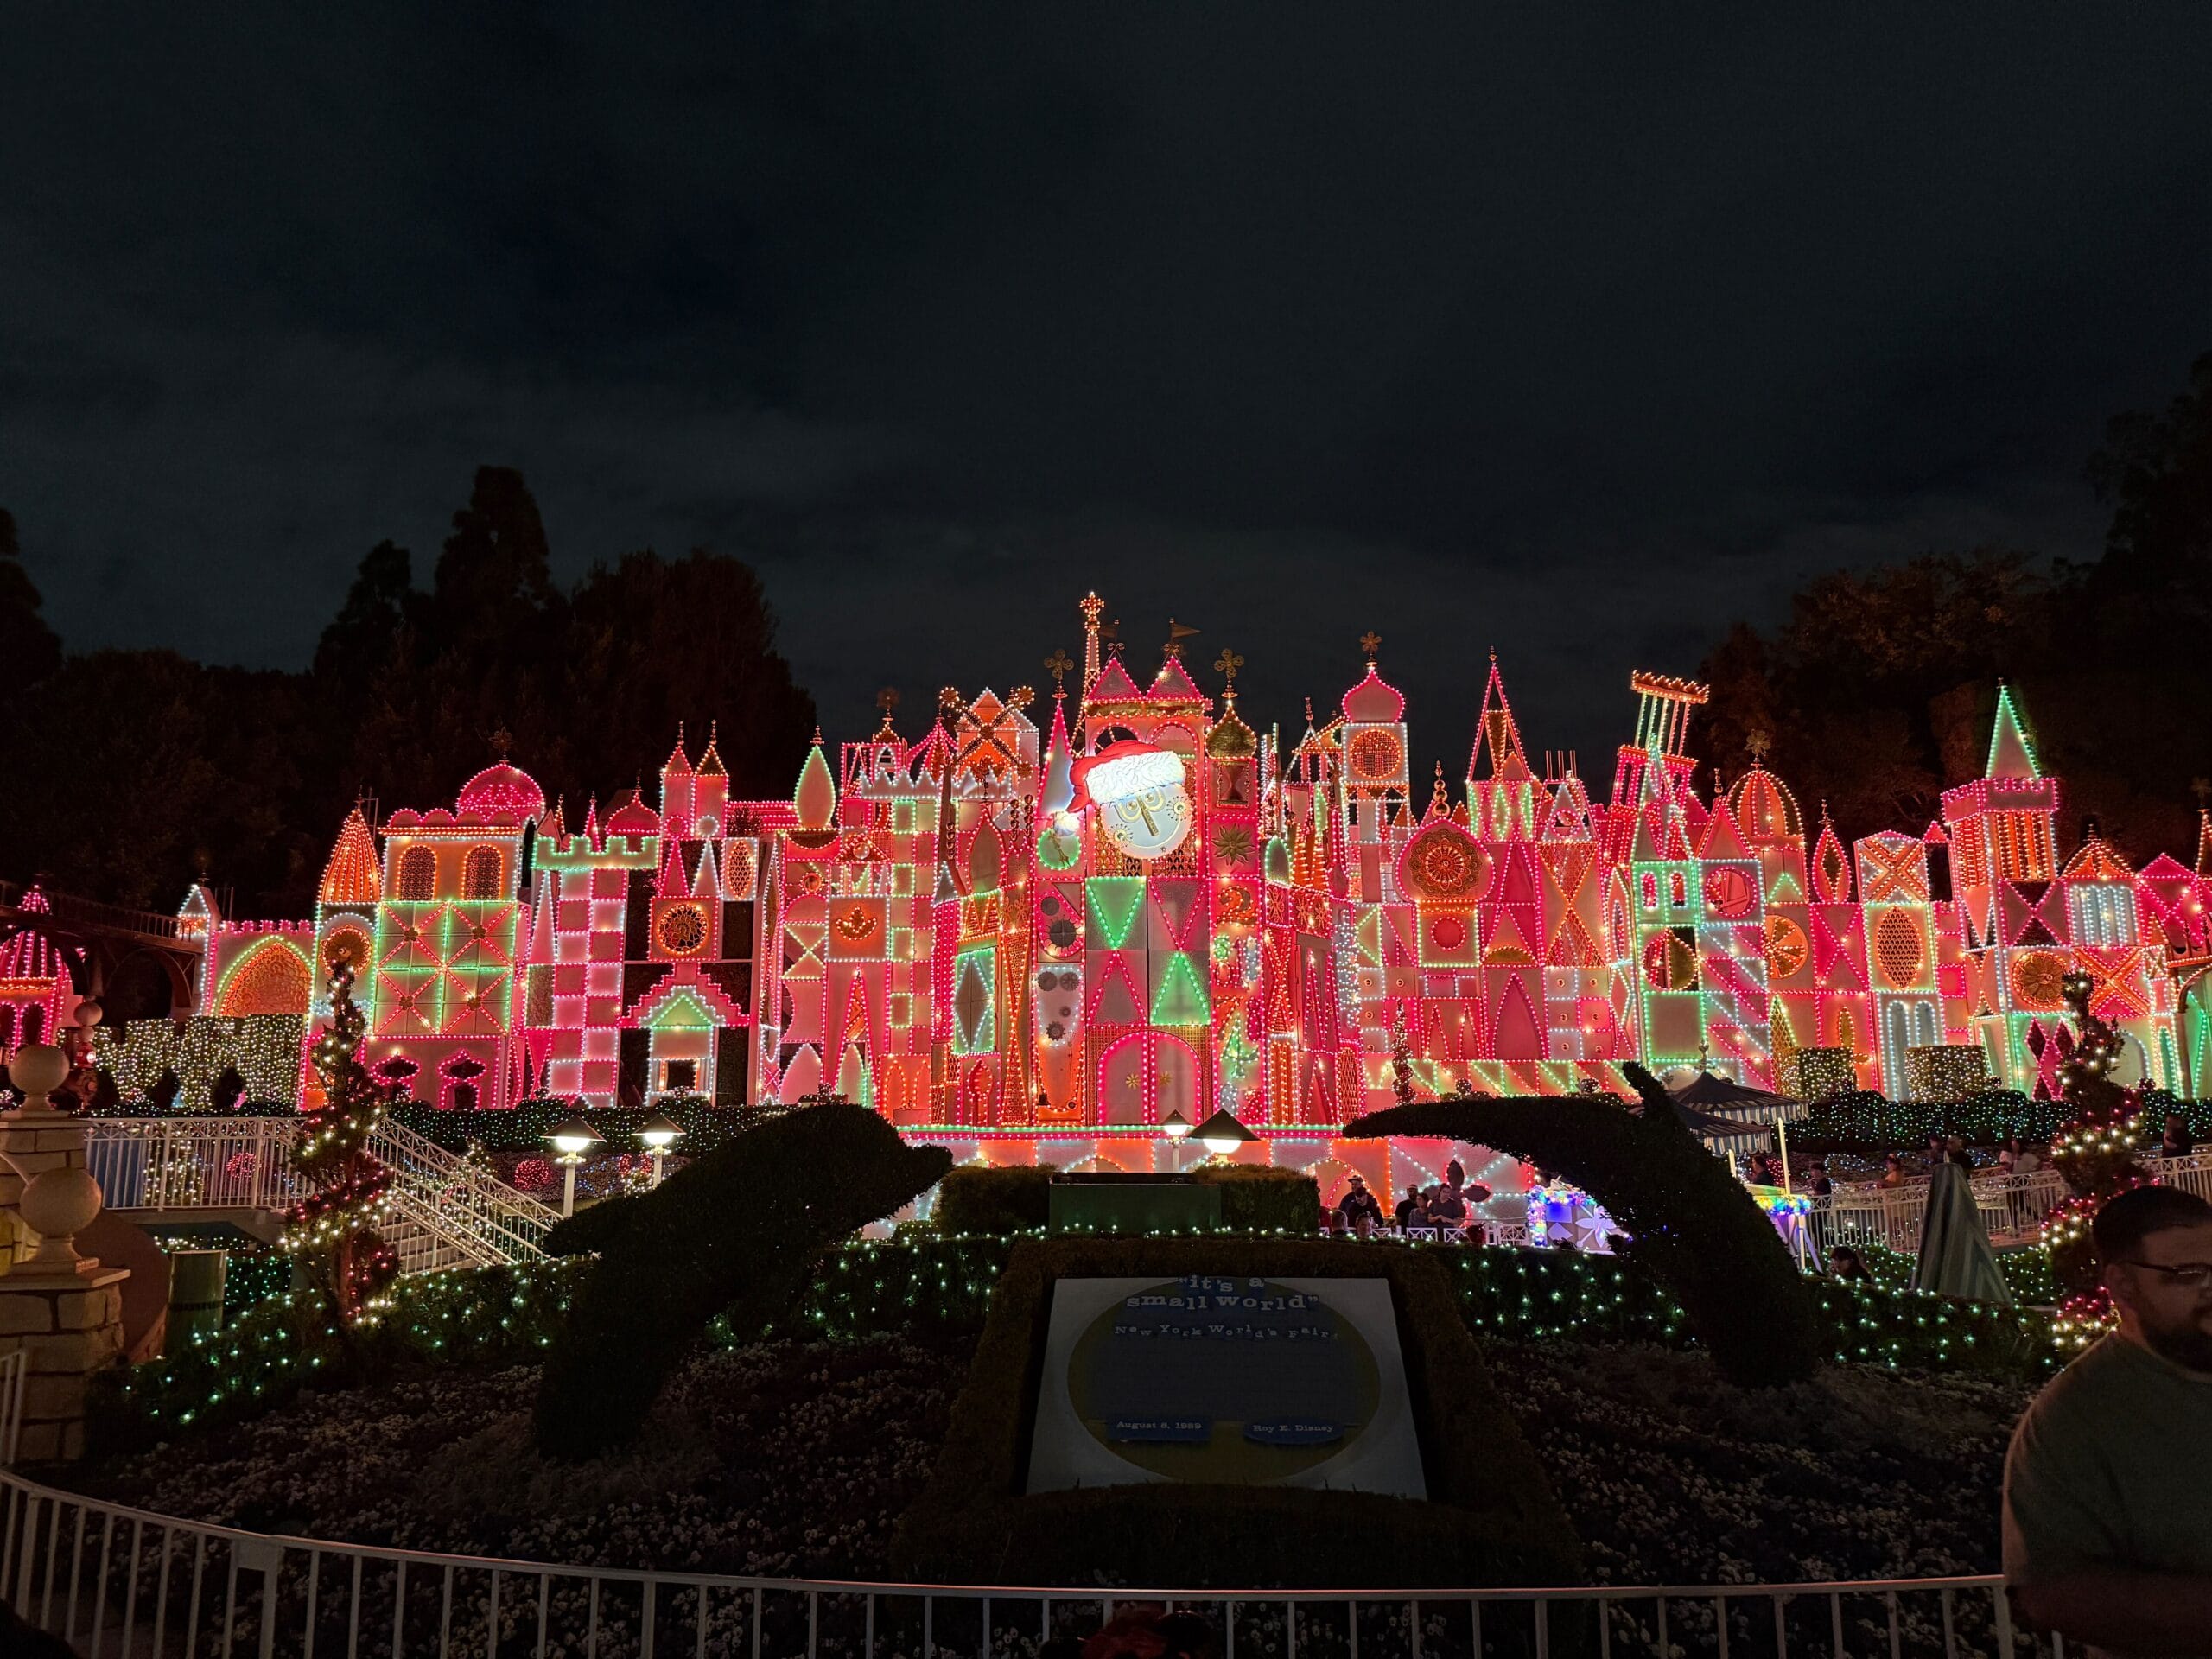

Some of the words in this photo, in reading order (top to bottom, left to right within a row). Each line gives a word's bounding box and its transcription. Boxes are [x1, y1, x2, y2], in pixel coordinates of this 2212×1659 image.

[1214, 886, 1259, 926] 2
[1249, 1276, 1265, 1287] a
[1126, 1295, 1208, 1311] small
[1114, 1325, 1153, 1338] New
[1159, 1324, 1204, 1338] York
[1208, 1324, 1278, 1339] World's
[1116, 1421, 1157, 1430] August
[1252, 1425, 1275, 1433] Roy
[1295, 1424, 1335, 1433] Disney
